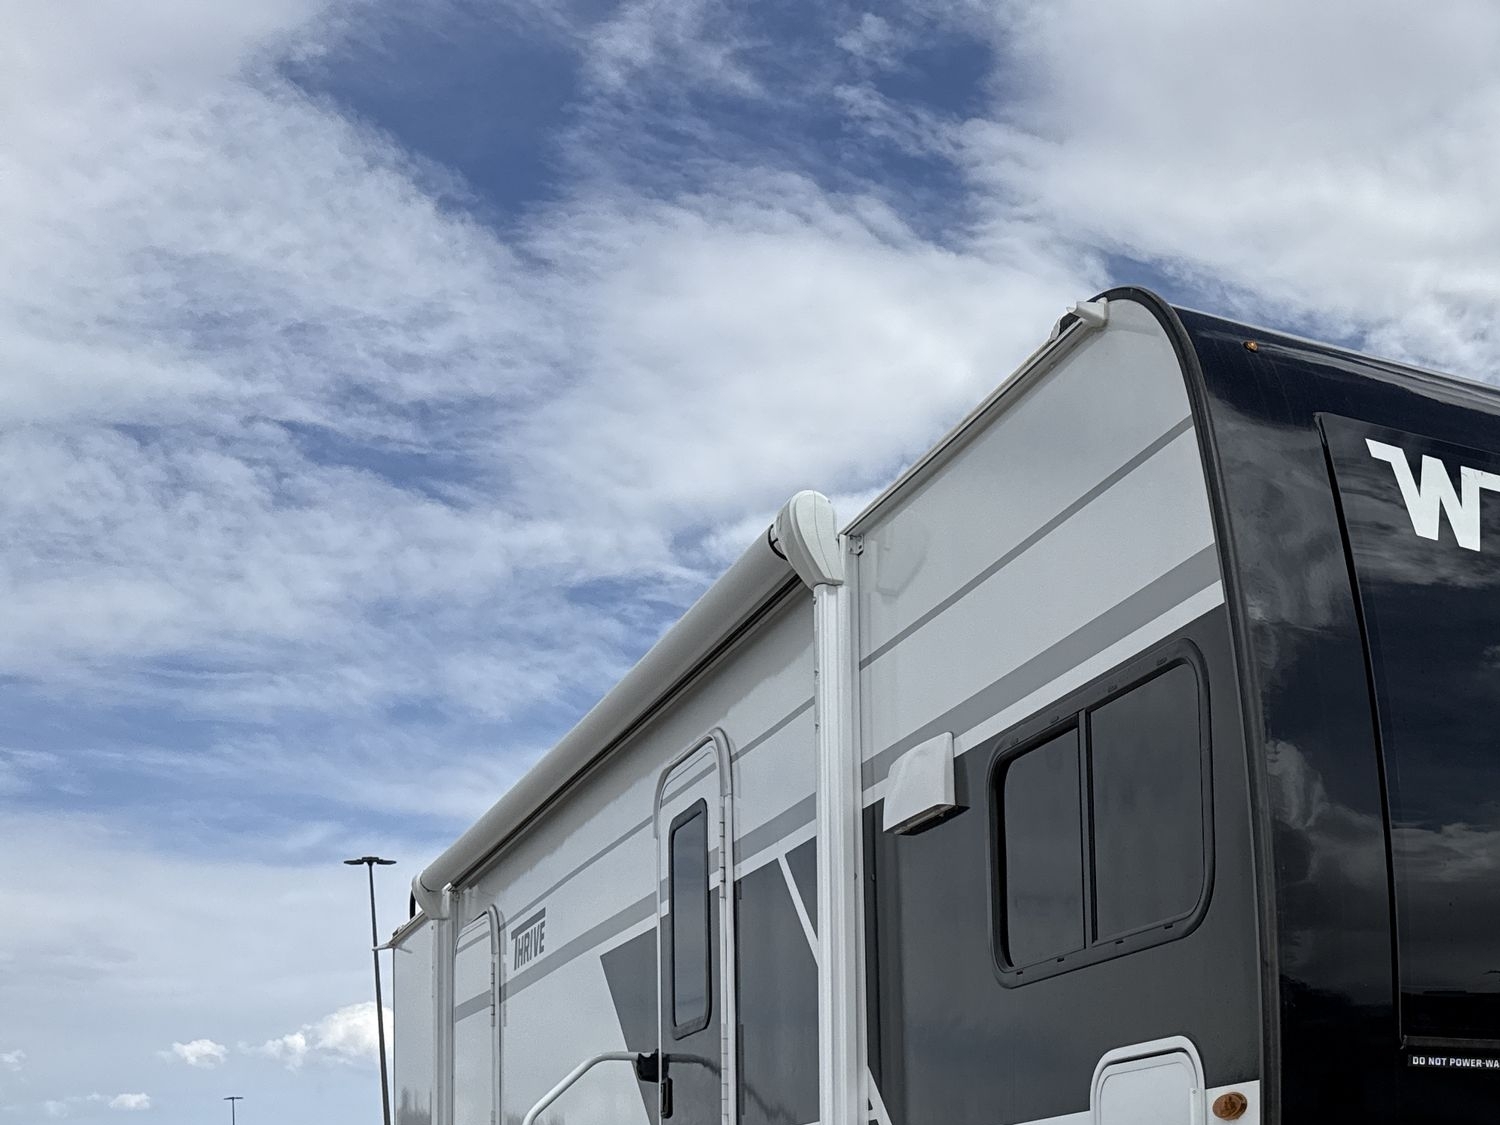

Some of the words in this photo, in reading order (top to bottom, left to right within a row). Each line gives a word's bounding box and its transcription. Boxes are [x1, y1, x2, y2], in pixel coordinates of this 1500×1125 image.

[511, 906, 546, 971] THRIVE
[1412, 1056, 1426, 1065] DO
[1428, 1057, 1447, 1066] NOT
